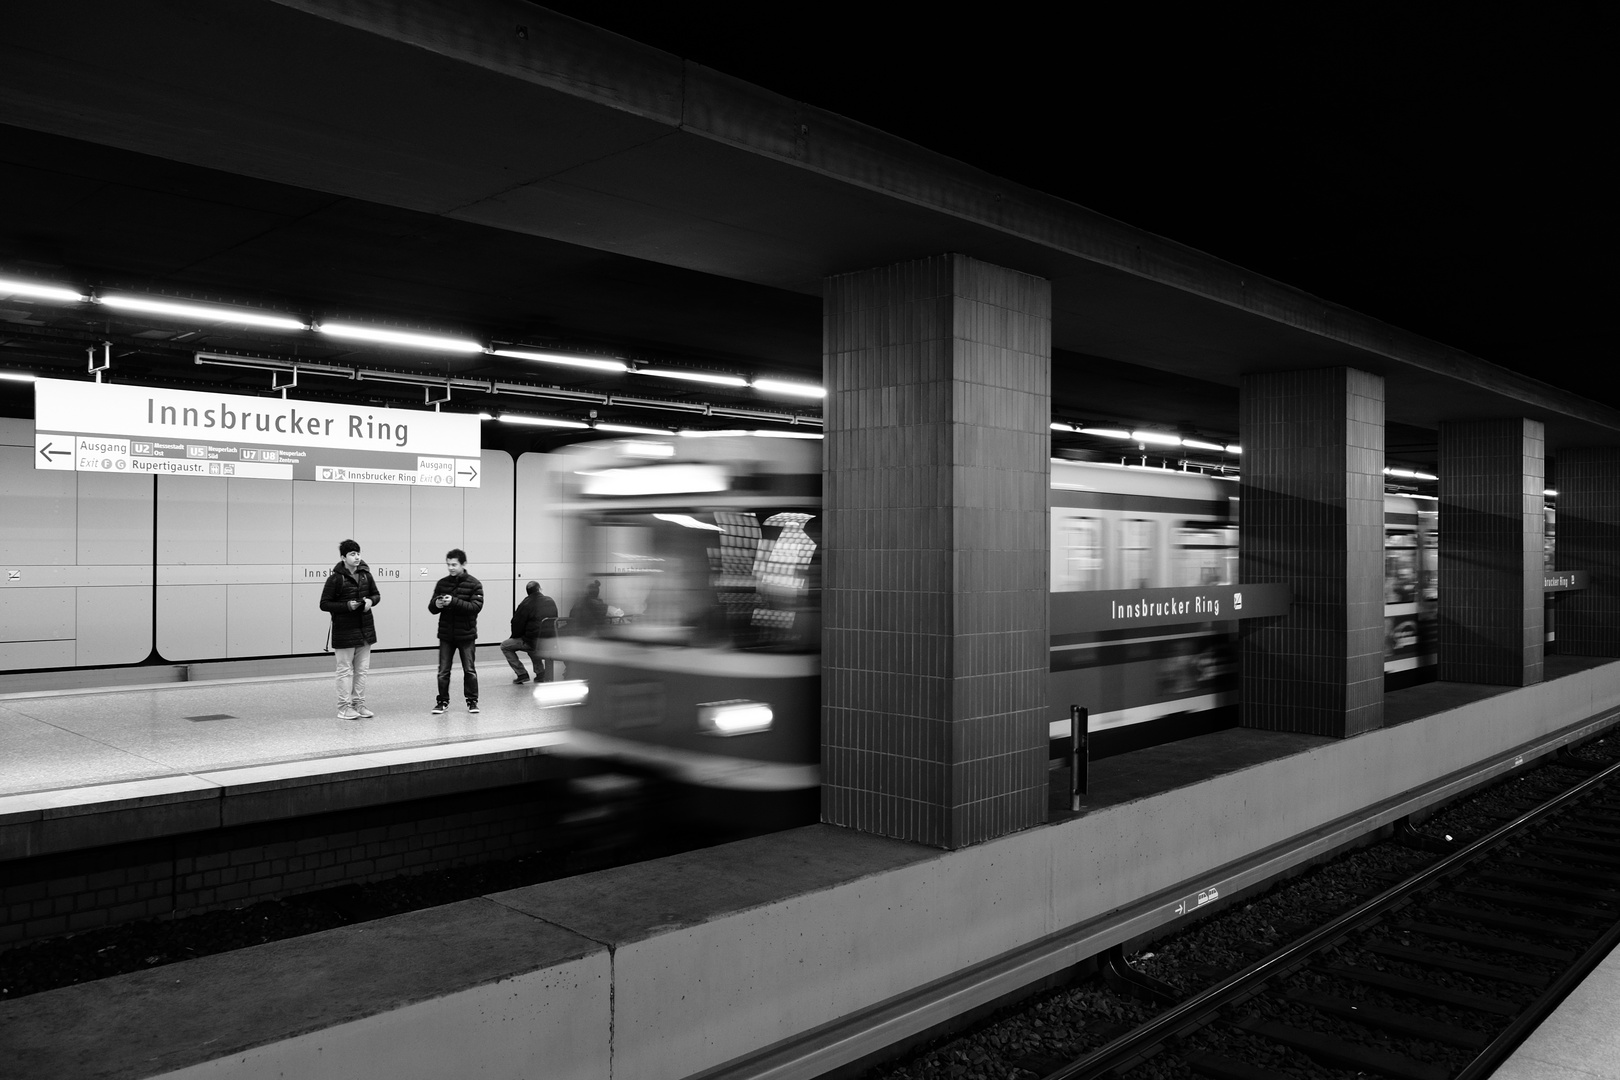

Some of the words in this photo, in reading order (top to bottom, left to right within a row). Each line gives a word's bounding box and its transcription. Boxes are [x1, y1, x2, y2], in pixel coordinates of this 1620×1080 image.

[148, 398, 334, 436] Innsbrucker
[349, 415, 408, 447] Ring
[80, 440, 126, 454] Ausgang
[134, 444, 150, 454] U2
[190, 447, 204, 456] U5
[243, 450, 256, 459] U7
[262, 451, 276, 460] U8
[80, 458, 98, 468] Exit
[132, 460, 204, 473] Rupertigaustr.
[420, 460, 452, 472] Ausgang
[348, 470, 395, 481] Innsbrucker
[398, 473, 416, 483] Ring
[420, 474, 432, 483] Exit
[378, 568, 400, 578] Ring
[1112, 598, 1190, 619] Innsbrucker
[1195, 596, 1219, 616] Ring
